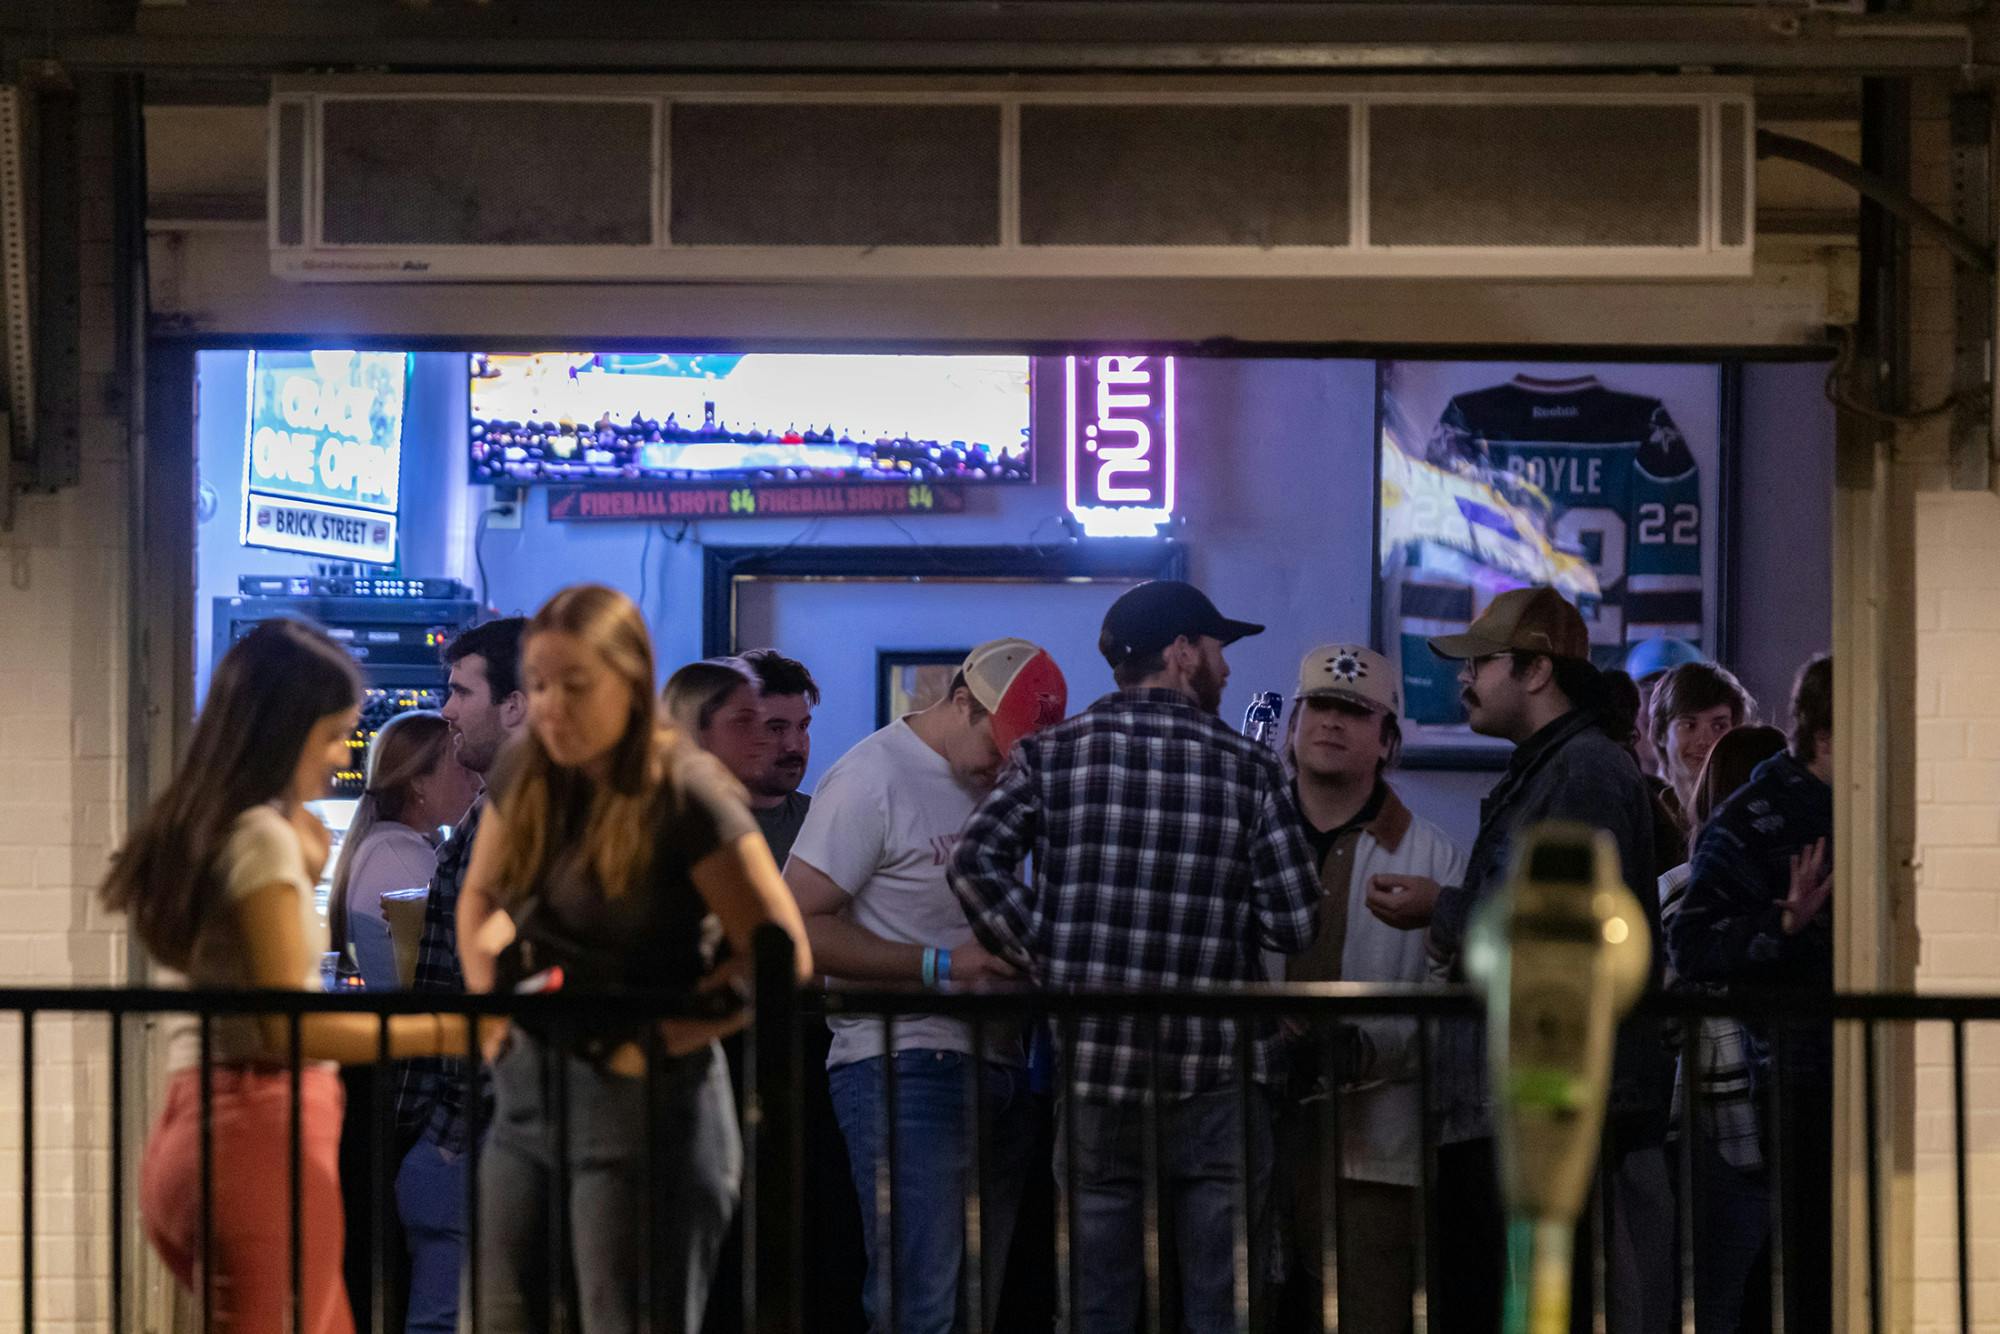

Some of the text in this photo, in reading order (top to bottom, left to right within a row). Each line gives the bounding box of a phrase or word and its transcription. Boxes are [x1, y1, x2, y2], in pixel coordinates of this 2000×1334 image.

[253, 427, 316, 485] ONE
[579, 484, 934, 516] FIREBALL SHOTS $4 FIREBALL SHOTS $4
[276, 509, 367, 545] BRICK STREET
[1638, 502, 1699, 545] 22
